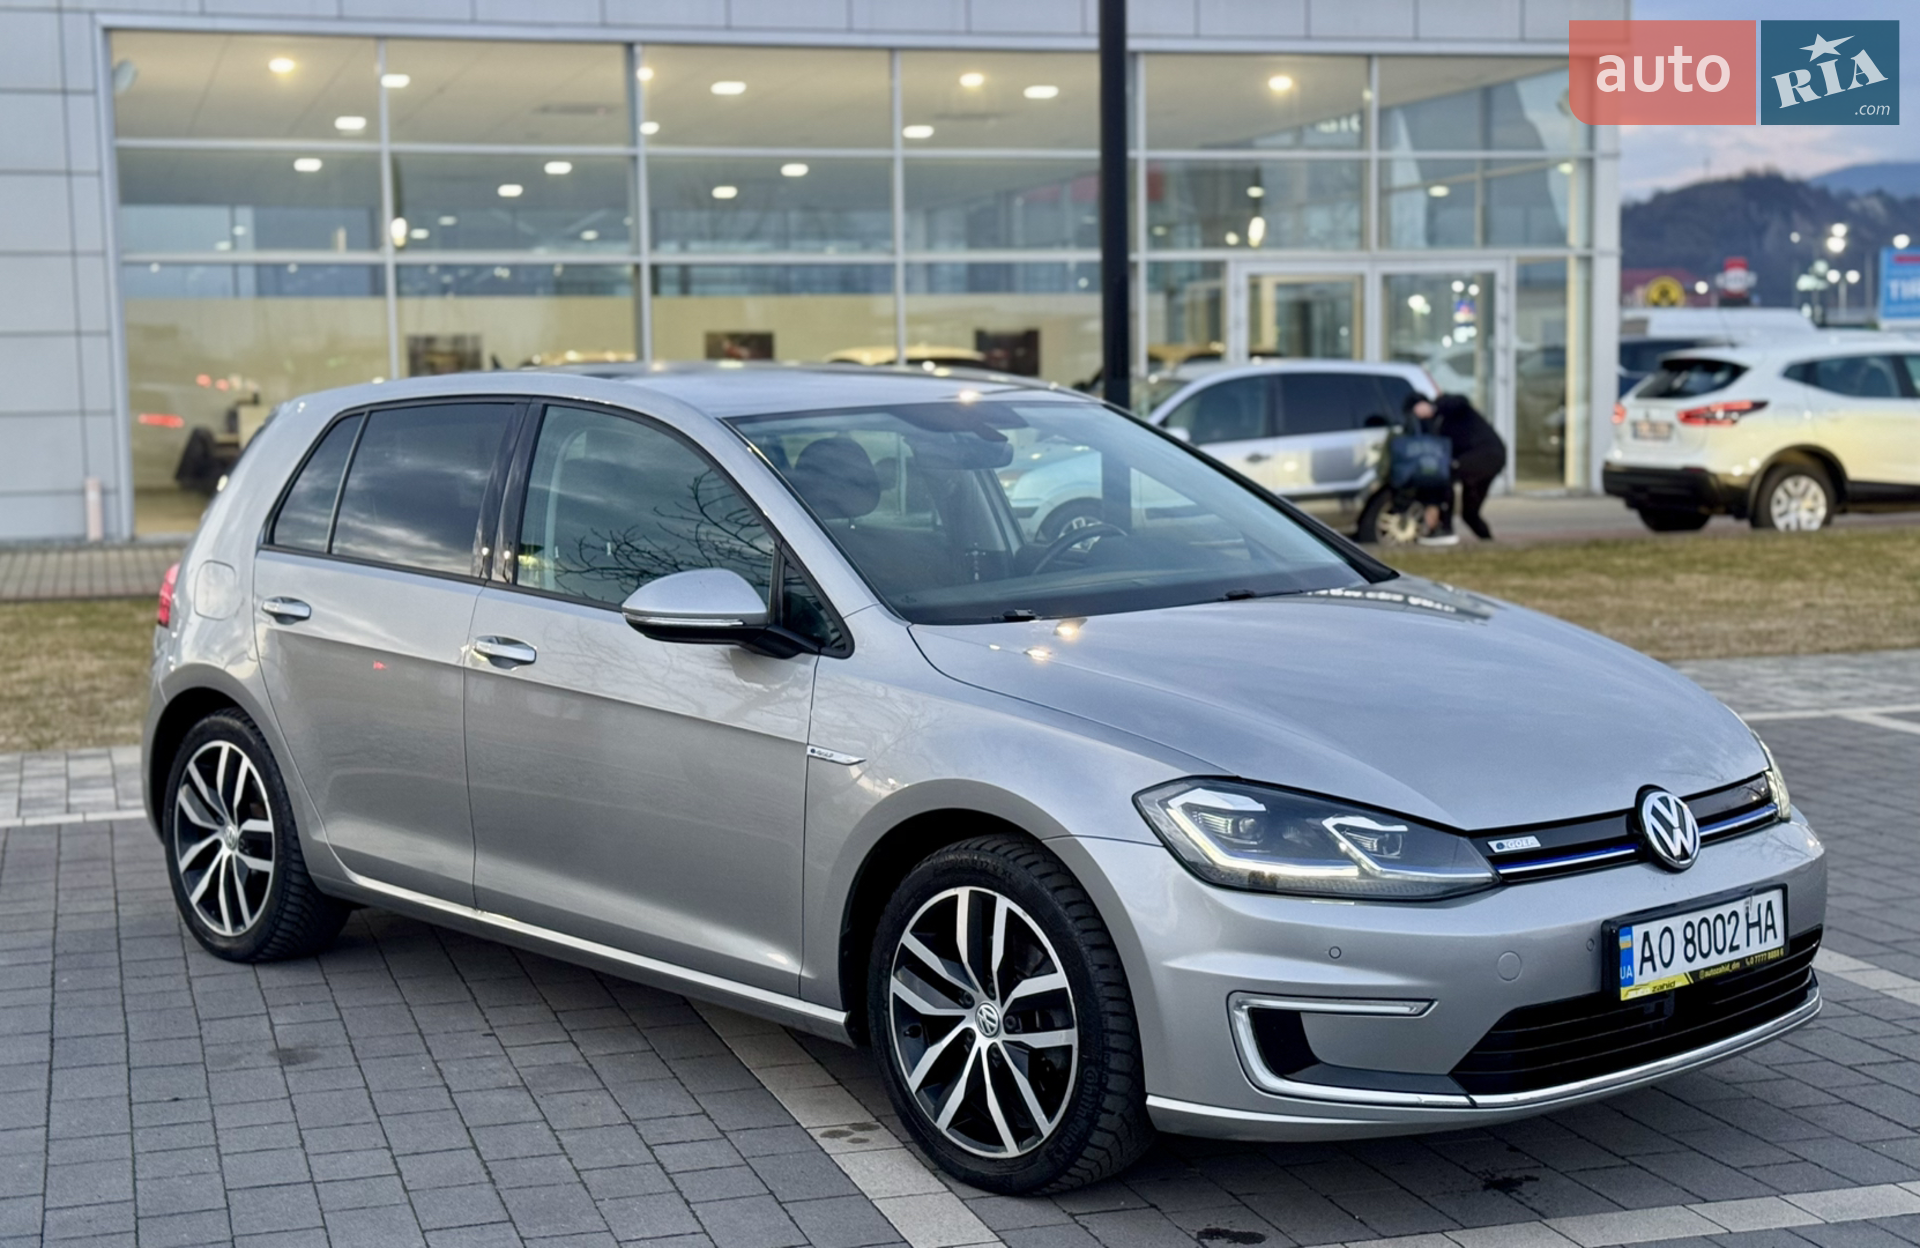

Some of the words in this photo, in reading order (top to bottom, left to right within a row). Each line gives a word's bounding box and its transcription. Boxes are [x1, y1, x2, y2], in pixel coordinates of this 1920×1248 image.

[1639, 926, 1676, 976] AO
[1683, 910, 1740, 964] 8002
[1745, 900, 1777, 948] HA
[1620, 966, 1633, 980] UA
